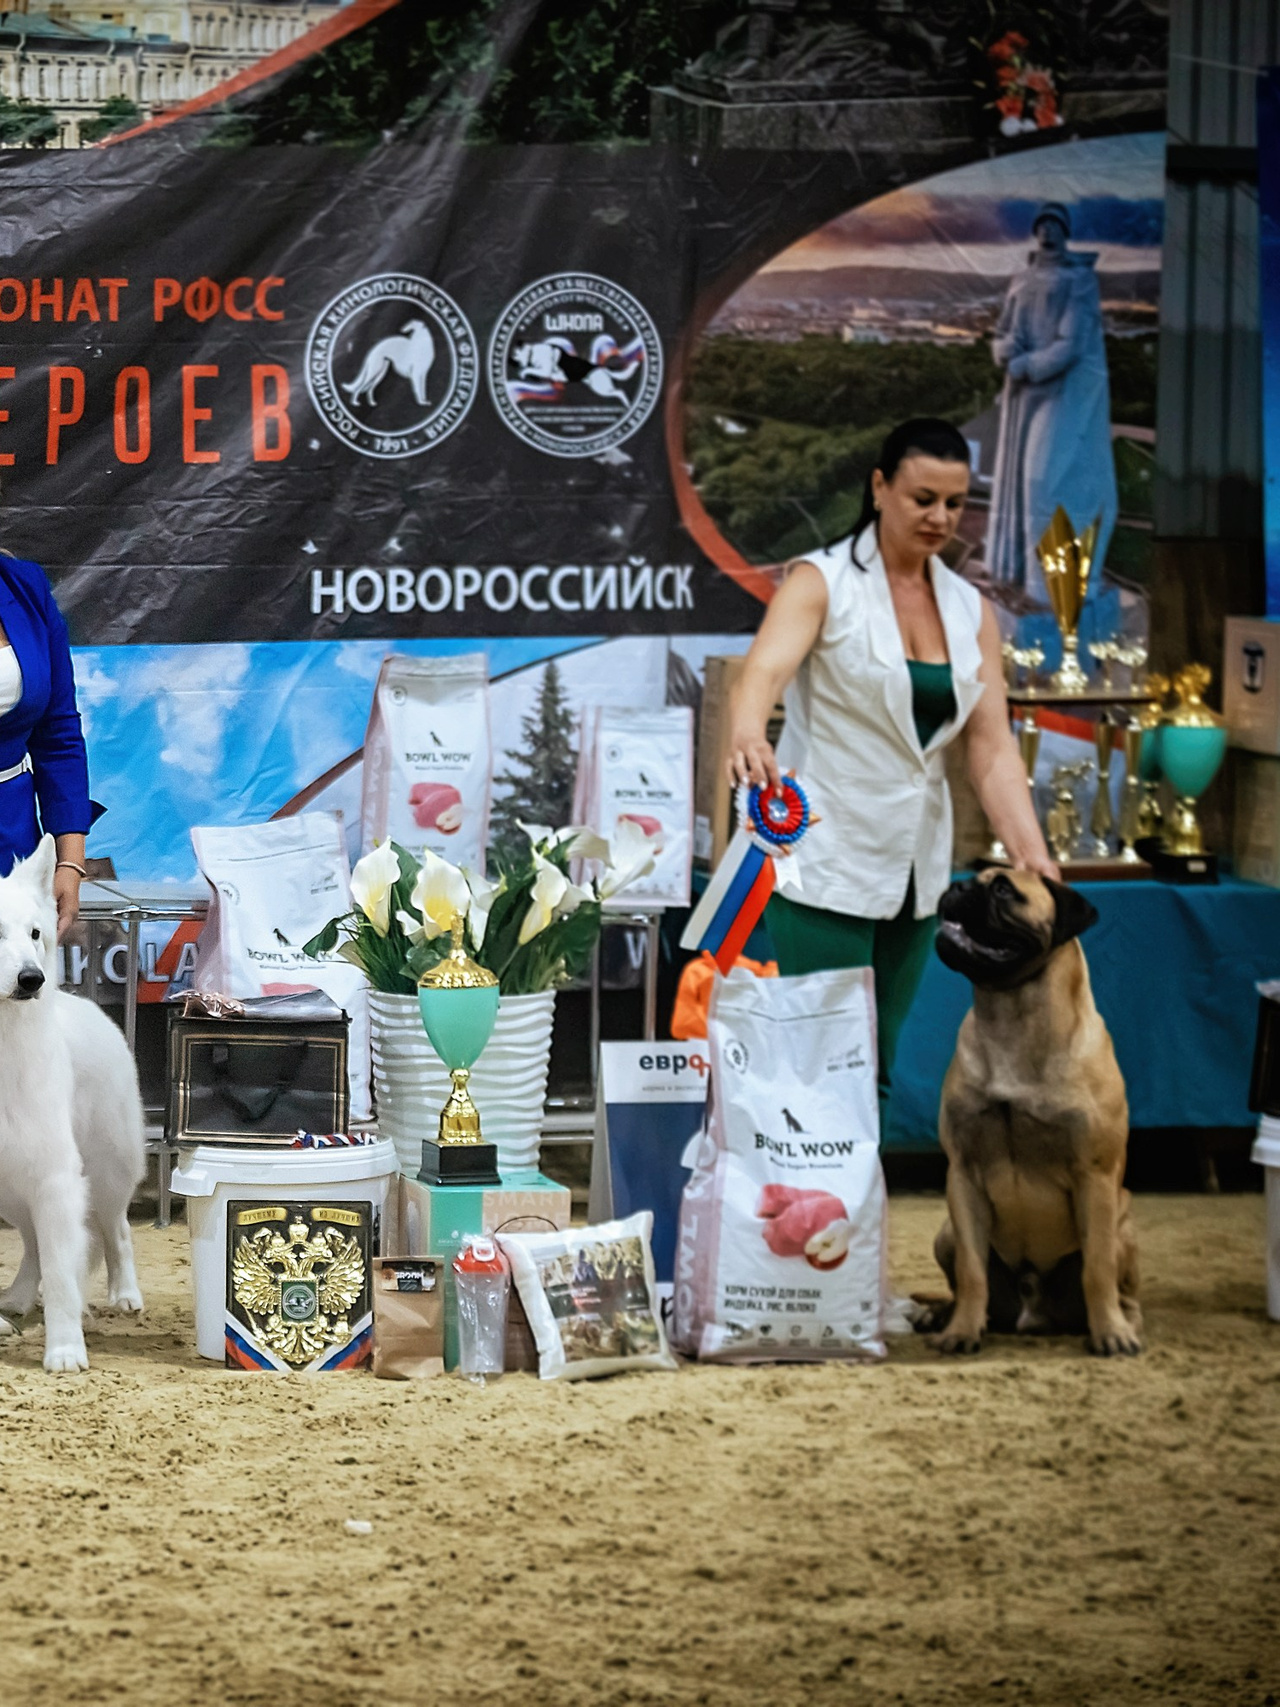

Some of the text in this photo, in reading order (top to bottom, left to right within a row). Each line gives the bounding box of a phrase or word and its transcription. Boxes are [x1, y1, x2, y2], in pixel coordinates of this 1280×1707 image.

[153, 276, 285, 323] РФСС
[312, 278, 474, 440] РОССИЙСКАЯ КИНОЛОГИЧЕСКАЯ ФЕДЕРАЦИЯ
[311, 555, 695, 614] НОВОРОССИЙСК
[801, 1140, 854, 1157] WOW
